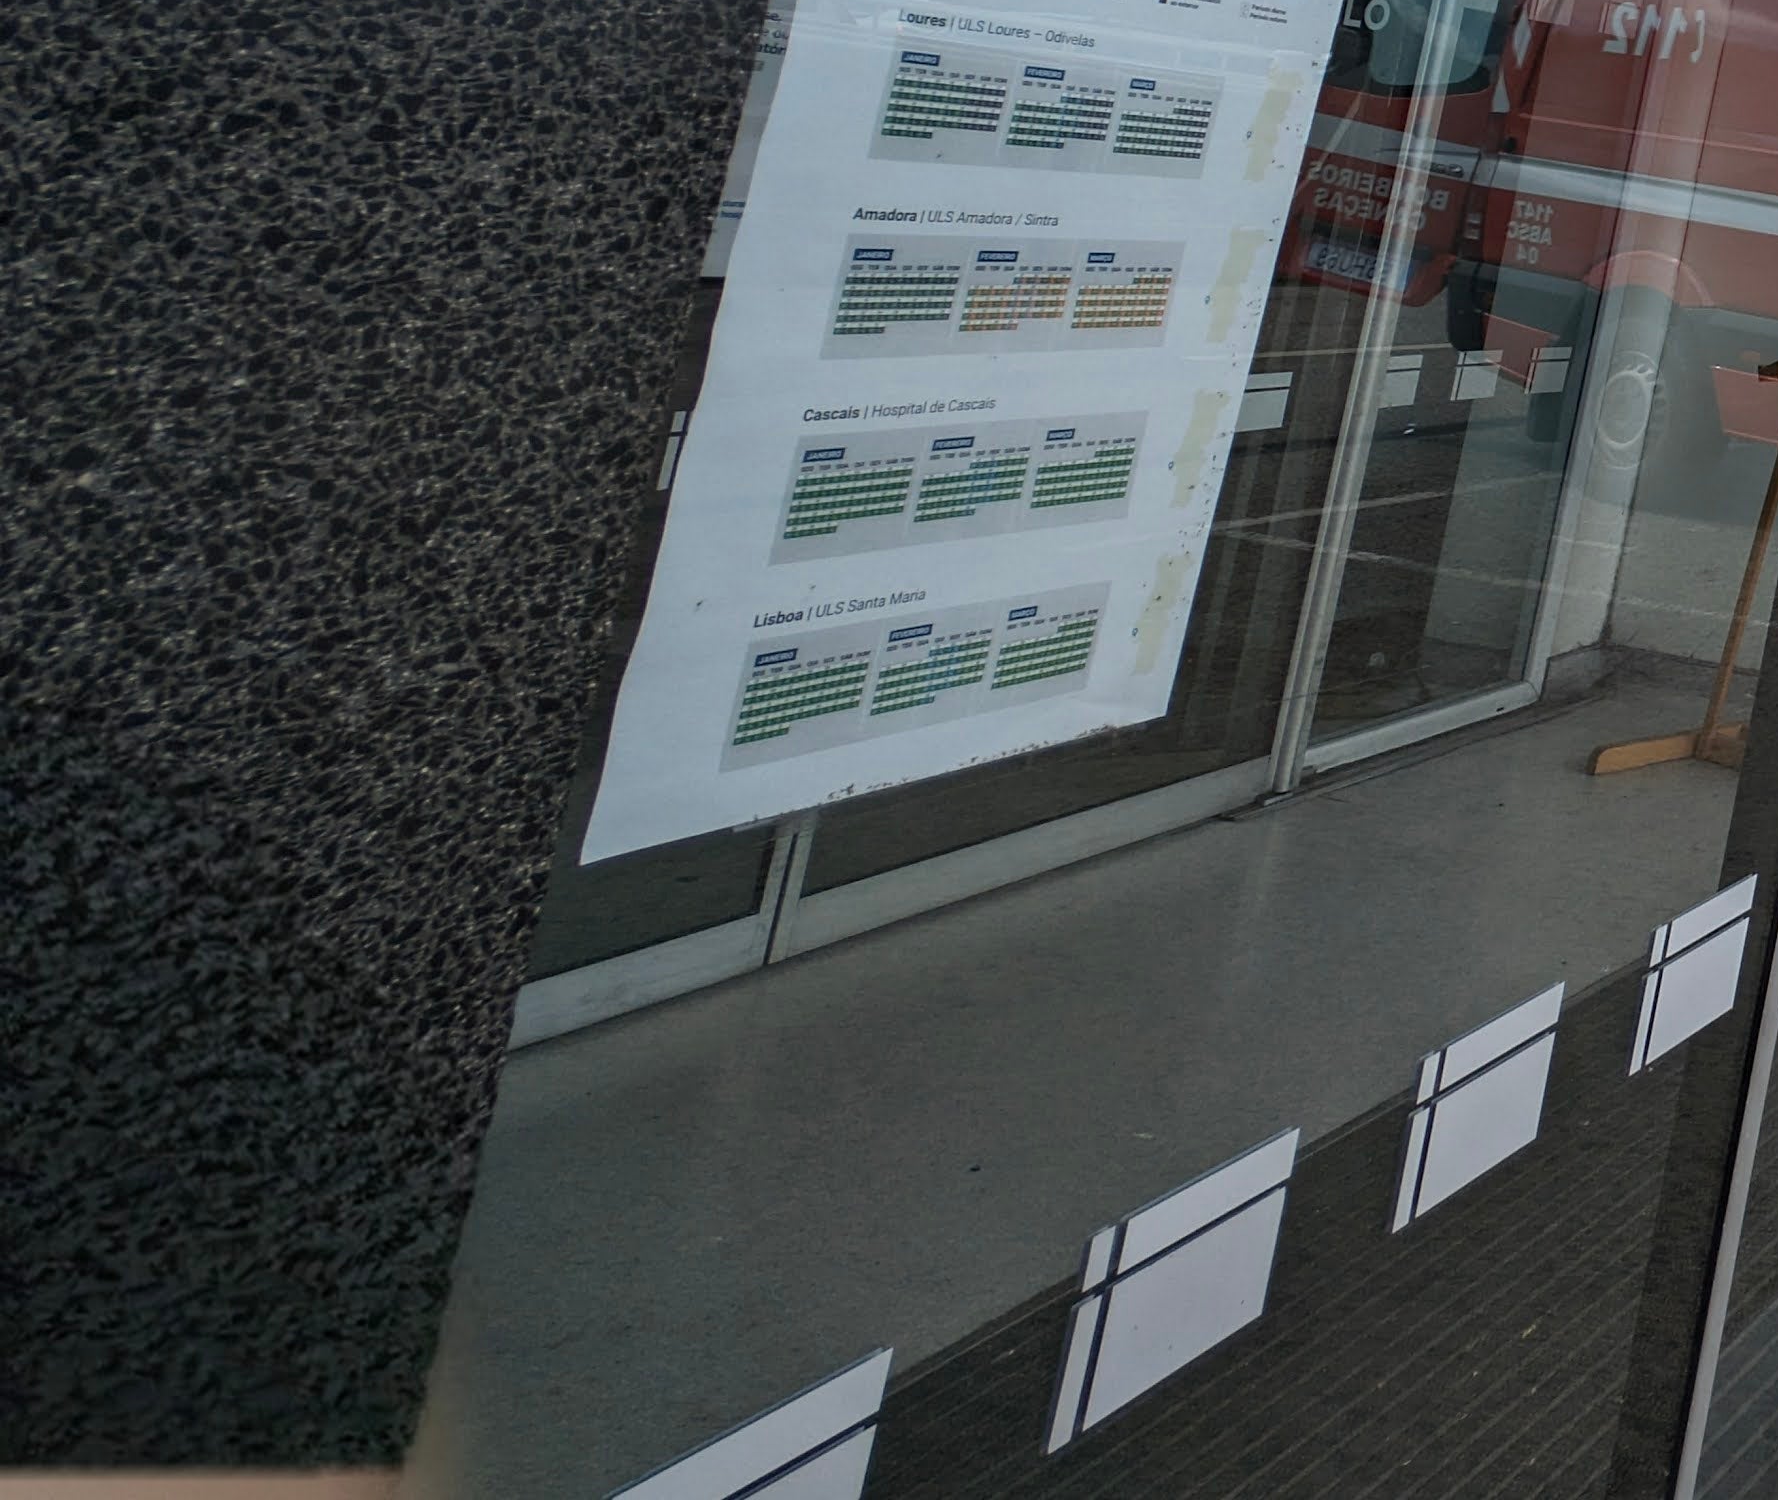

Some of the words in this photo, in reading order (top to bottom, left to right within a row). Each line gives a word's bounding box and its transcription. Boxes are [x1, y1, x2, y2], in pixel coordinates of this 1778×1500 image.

[898, 8, 946, 28] Loures
[958, 20, 984, 33] ULS
[988, 22, 1030, 39] Loures
[1045, 29, 1095, 48] Odivelas
[852, 207, 917, 222] Amadora
[927, 210, 954, 223] ULS
[956, 211, 1013, 226] Amadora
[1024, 213, 1059, 227] Sintra
[803, 406, 860, 422] Cascais
[871, 400, 927, 419] Hospital
[930, 399, 946, 413] de
[948, 397, 996, 412] Cascais
[753, 610, 804, 628] Lisboa
[815, 601, 845, 619] ULS
[847, 596, 886, 614] Santa
[888, 589, 927, 606] Maria
